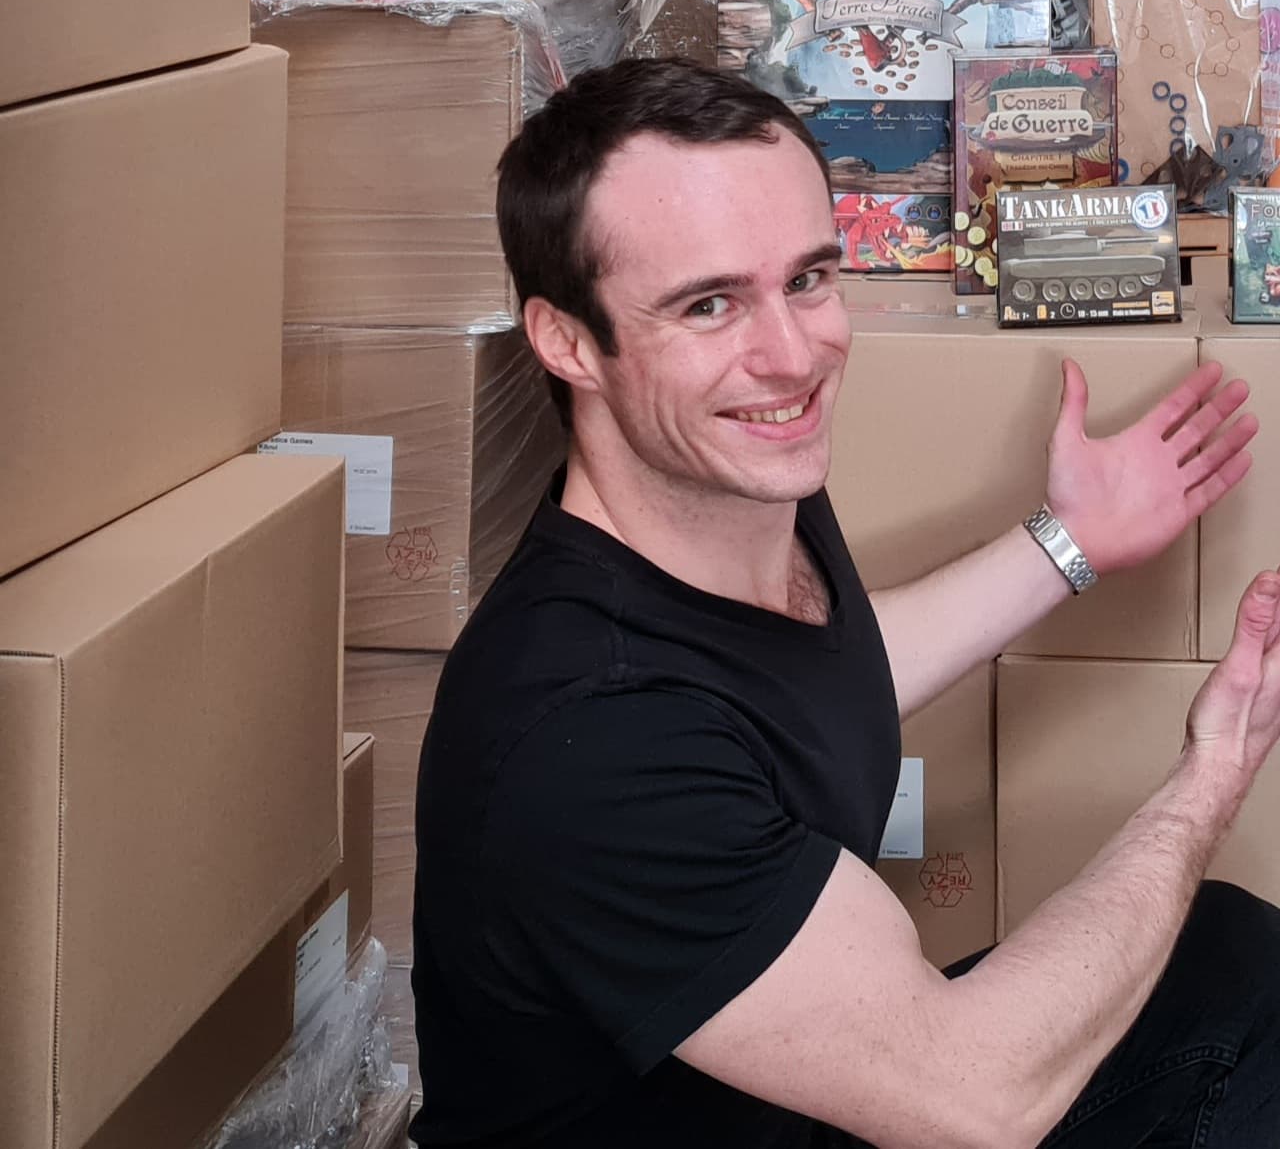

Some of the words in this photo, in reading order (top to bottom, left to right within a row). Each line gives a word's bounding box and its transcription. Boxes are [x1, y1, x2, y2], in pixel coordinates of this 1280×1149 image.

[1002, 93, 1067, 110] Conseil
[989, 116, 1008, 131] de
[1012, 114, 1089, 133] Guerre
[1001, 191, 1164, 220] TANKARMA
[290, 437, 313, 445] Games
[928, 873, 966, 889] REZY
